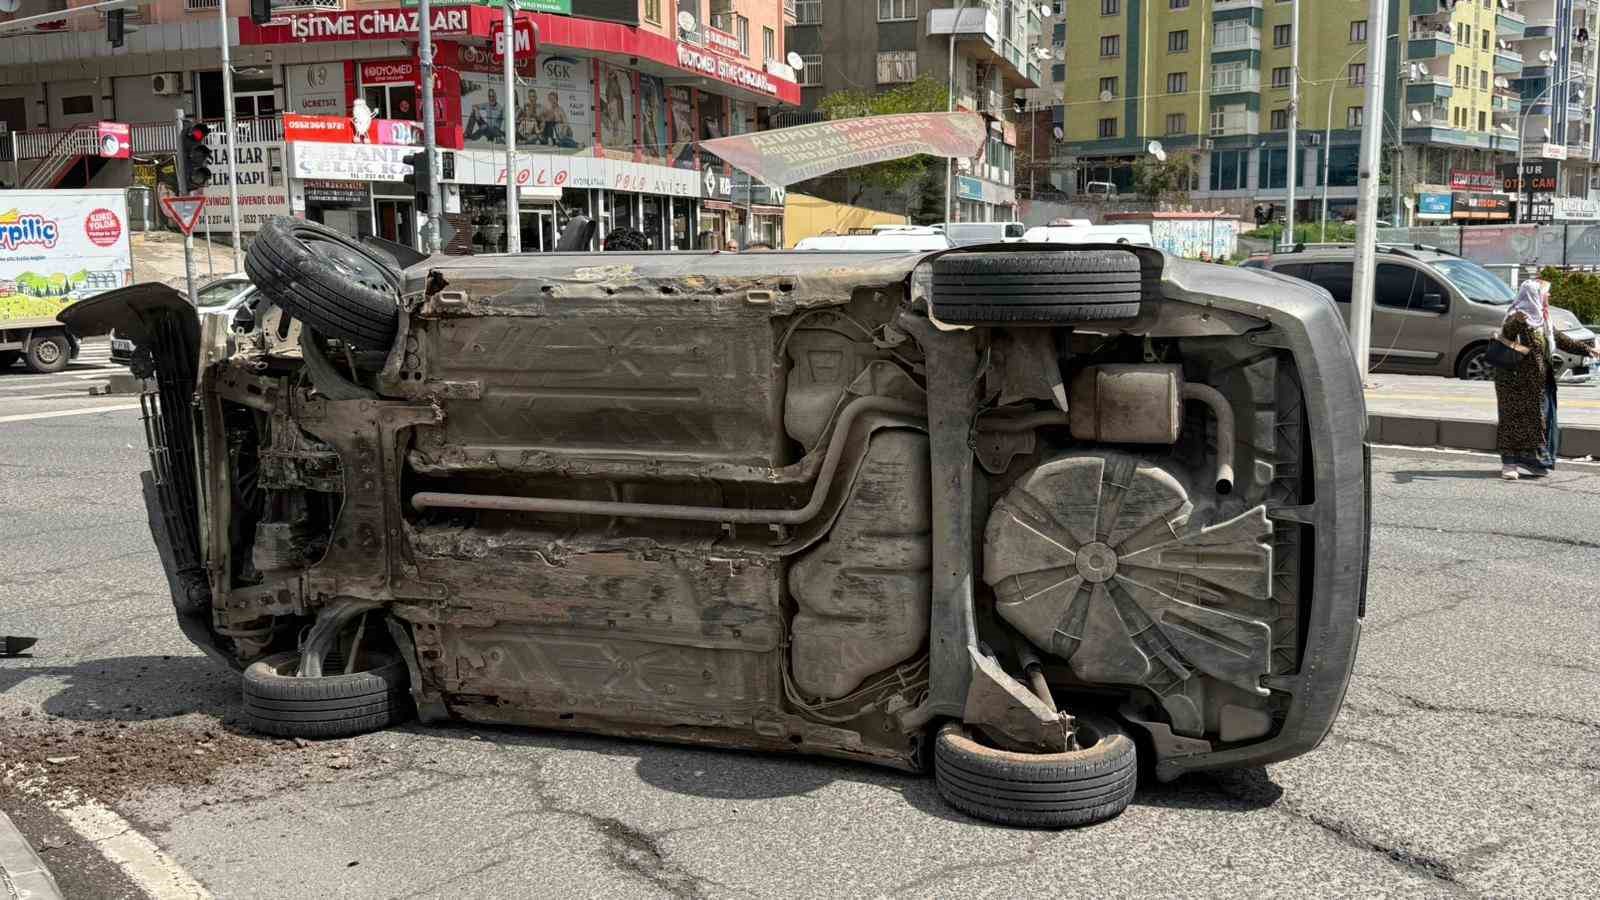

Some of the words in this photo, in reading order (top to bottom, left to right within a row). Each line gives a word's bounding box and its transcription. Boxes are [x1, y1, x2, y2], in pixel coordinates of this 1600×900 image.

[291, 13, 355, 43] İŞİTME
[360, 9, 467, 34] CİHAZARI
[496, 29, 530, 54] BM
[546, 62, 570, 78] SGK
[236, 171, 265, 185] KAPI
[654, 177, 689, 194] AVİZE
[1532, 178, 1555, 189] CAM
